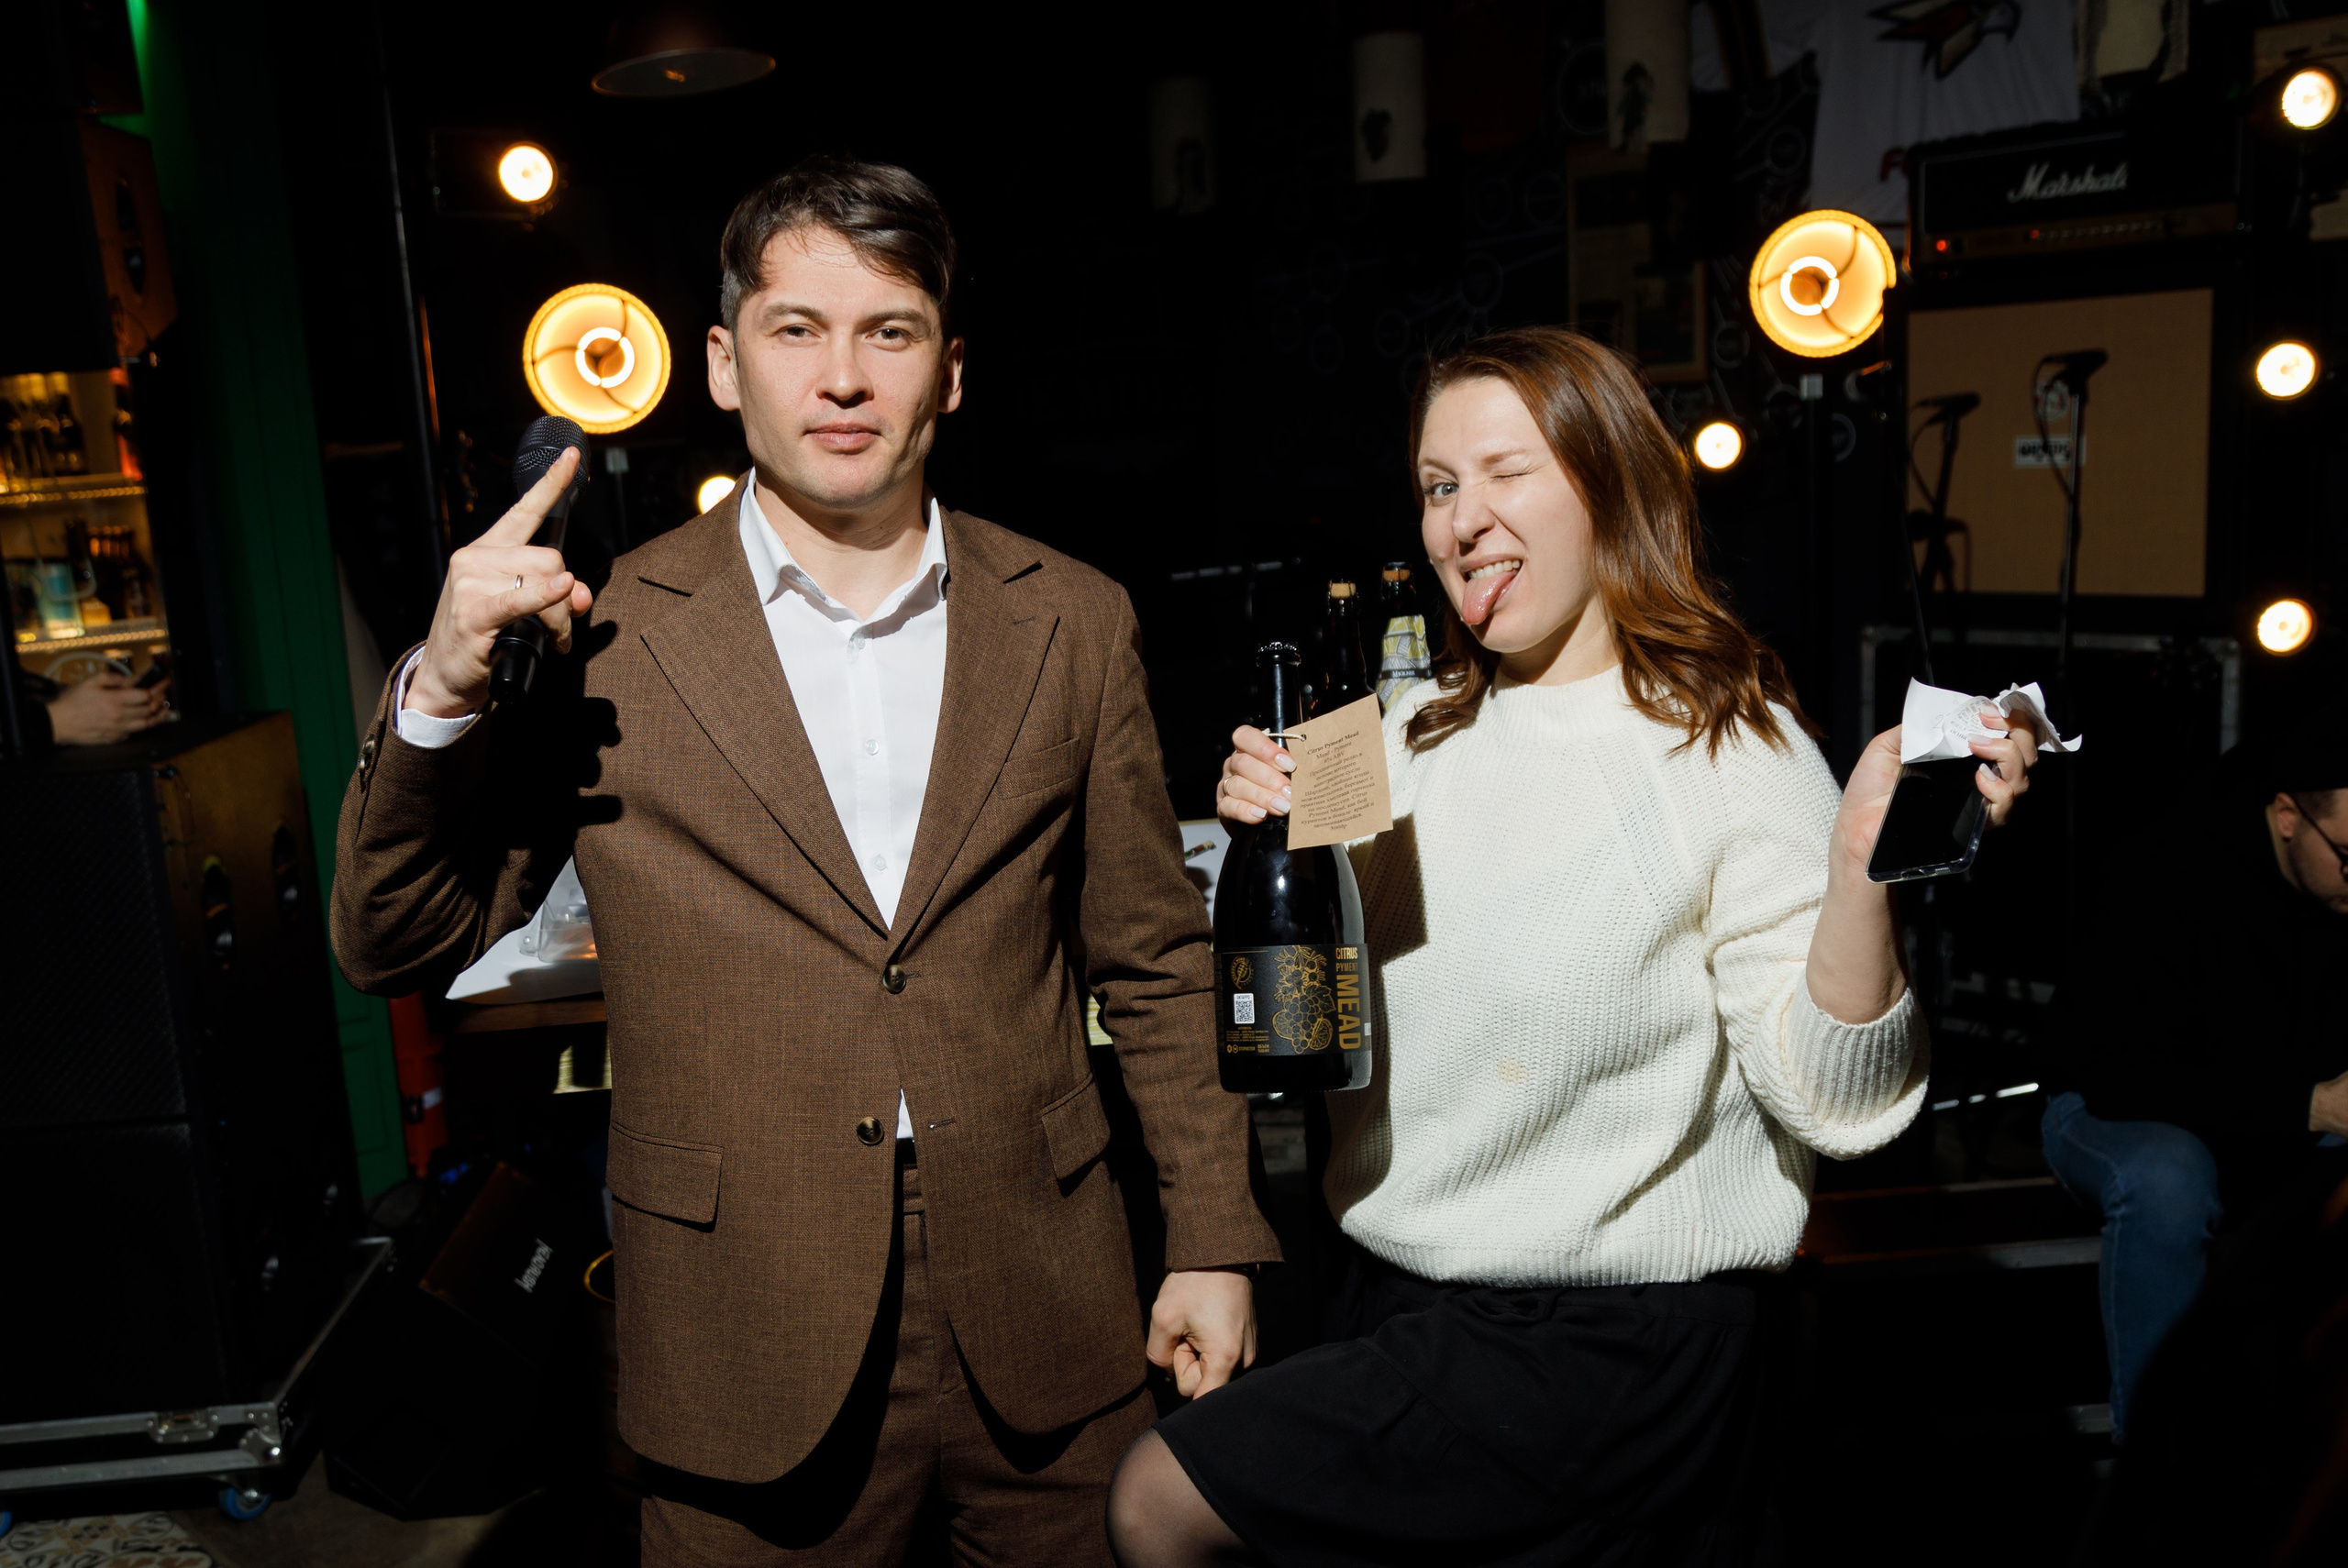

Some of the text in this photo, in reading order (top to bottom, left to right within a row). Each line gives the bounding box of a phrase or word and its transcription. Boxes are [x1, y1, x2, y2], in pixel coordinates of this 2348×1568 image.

[2005, 160, 2131, 204] Marshall
[1307, 731, 1359, 755] Citrus Pyment Mead
[1316, 750, 1330, 759] Mead
[1335, 742, 1351, 752] Pyment
[1333, 751, 1345, 759] ABV
[1310, 759, 1342, 777] Праздничный
[1344, 755, 1357, 763] релиз
[1316, 762, 1357, 780] основе которого
[1313, 767, 1360, 788] виноградное сусло
[1332, 777, 1352, 787] хвойные
[1354, 770, 1369, 778] ягоды
[1345, 778, 1368, 788] бергамот
[1301, 782, 1375, 808] приятная хмелевая горчинка
[1352, 791, 1368, 800] Citrus
[1335, 946, 1358, 960] CITRUS
[1335, 962, 1358, 972] PYMENT
[1335, 974, 1362, 1050] MEAD
